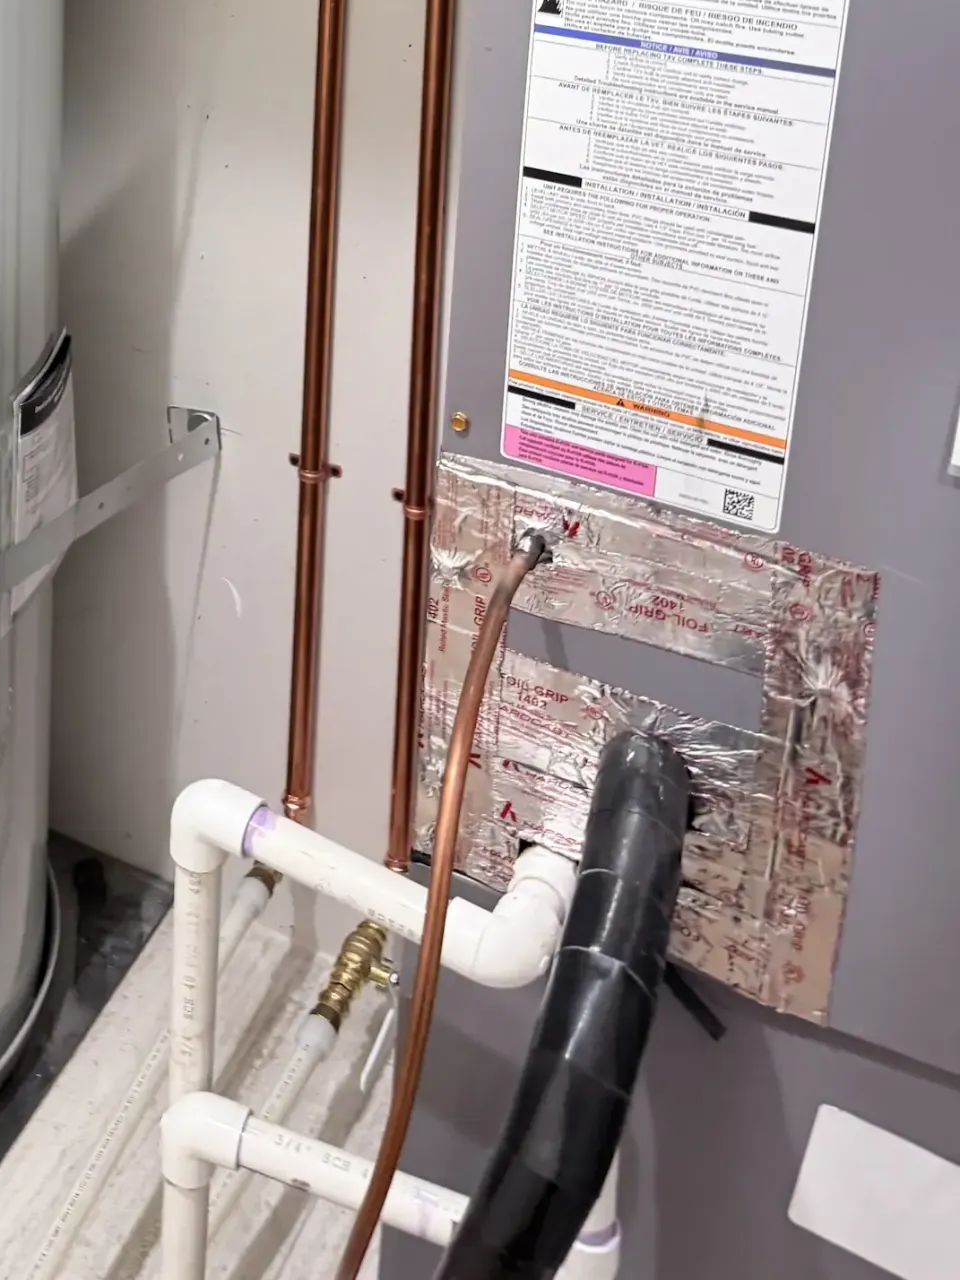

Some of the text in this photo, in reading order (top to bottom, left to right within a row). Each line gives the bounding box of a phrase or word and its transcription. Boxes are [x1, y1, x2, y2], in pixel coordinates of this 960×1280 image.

[639, 2, 670, 13] RISQUE
[685, 9, 702, 18] FEU
[708, 12, 741, 23] RIESGO
[756, 19, 798, 30] INCENDIO
[640, 41, 719, 60] NOTICE AVIS AVISO
[585, 181, 746, 218] INSTALLATION INSTALLATION INSTALACIÓN
[632, 403, 671, 418] WARNING
[652, 594, 684, 613] 1402
[628, 605, 708, 633] FOIL-GRIP
